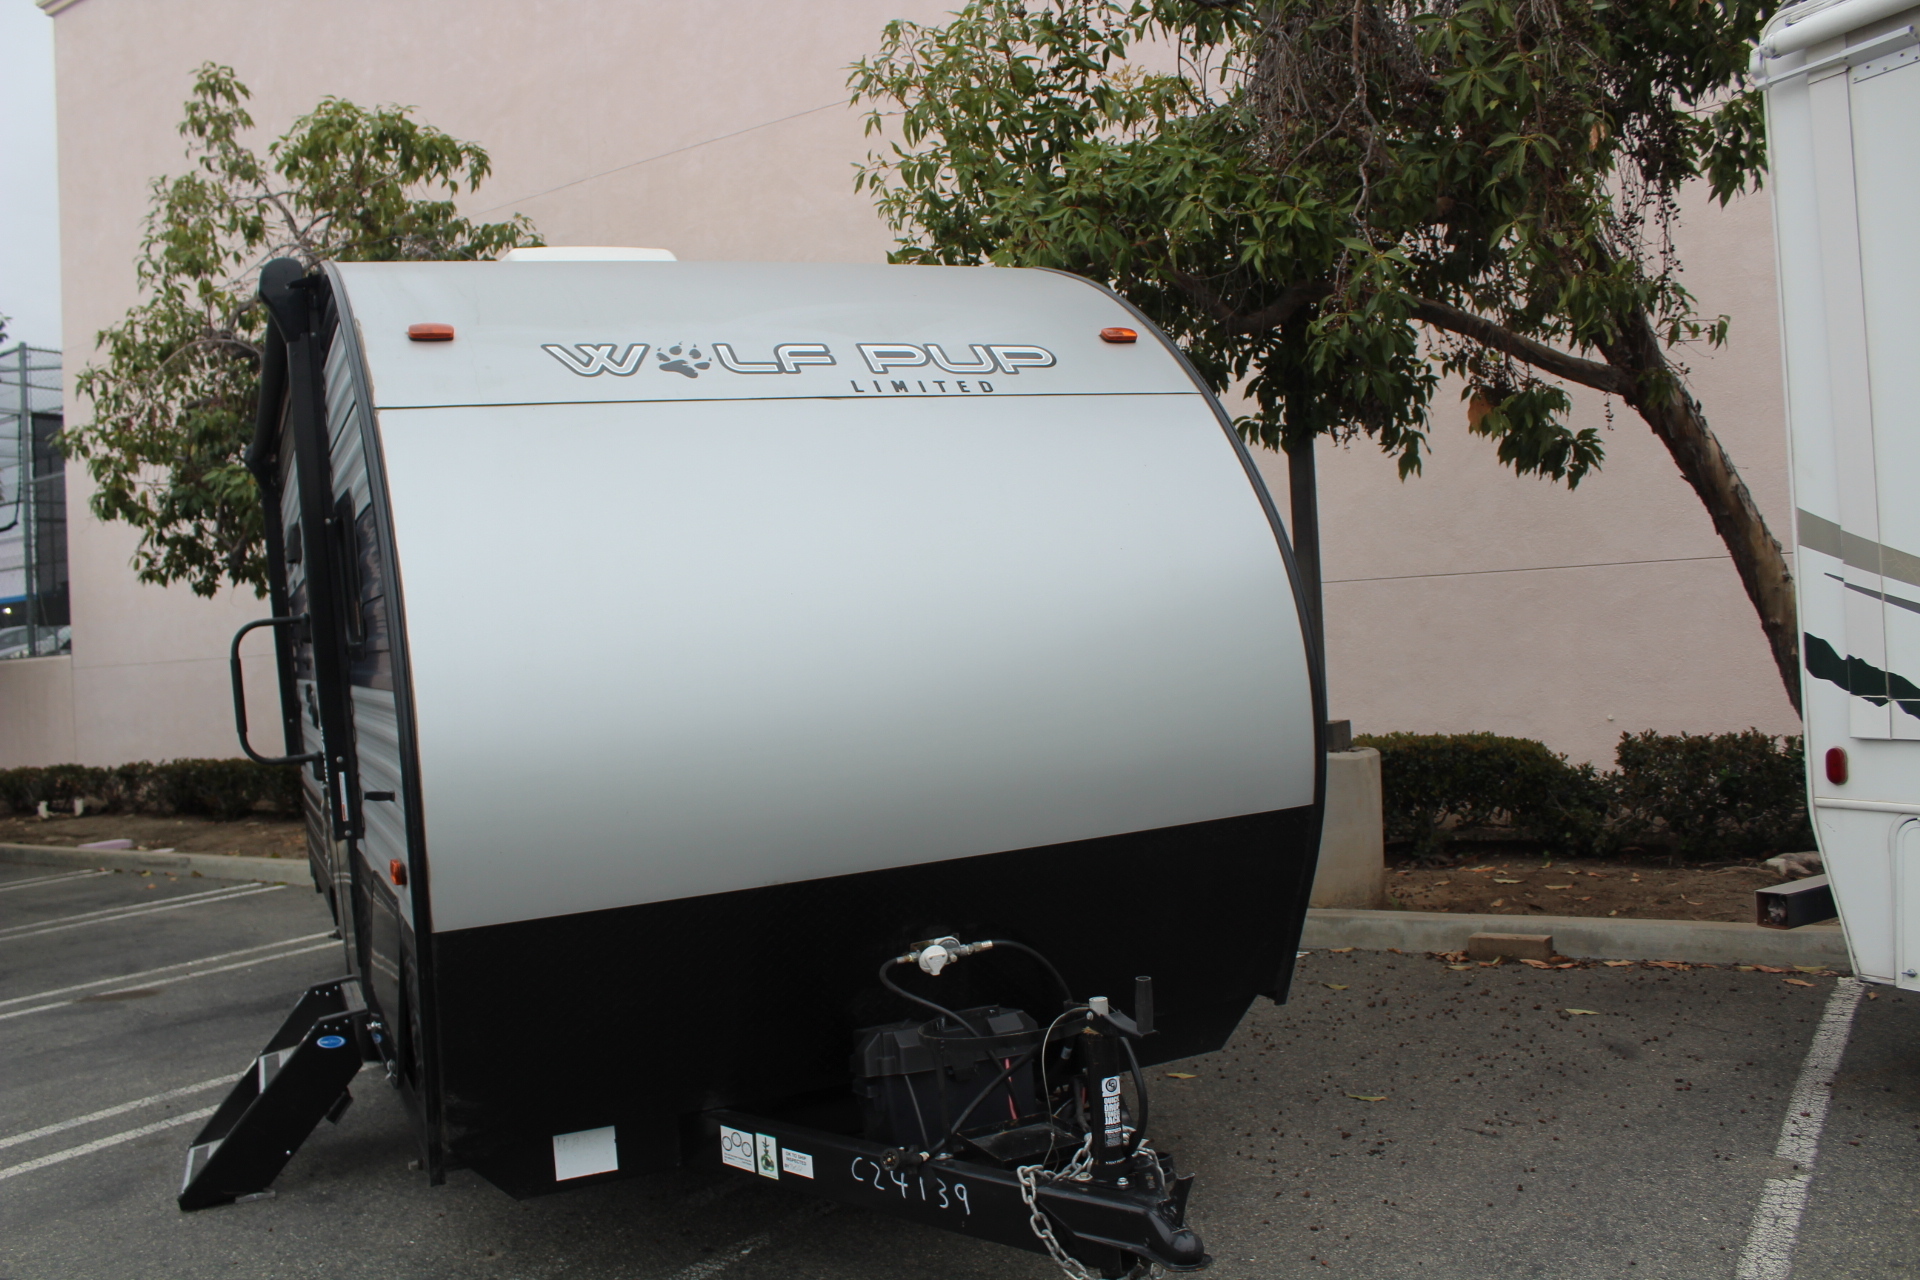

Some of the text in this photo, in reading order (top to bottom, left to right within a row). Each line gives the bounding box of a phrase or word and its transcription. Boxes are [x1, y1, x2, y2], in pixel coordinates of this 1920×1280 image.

[855, 342, 1057, 374] PUP
[849, 379, 994, 393] LIMITED
[1104, 1115, 1121, 1125] JACK
[851, 1156, 971, 1216] C24139
